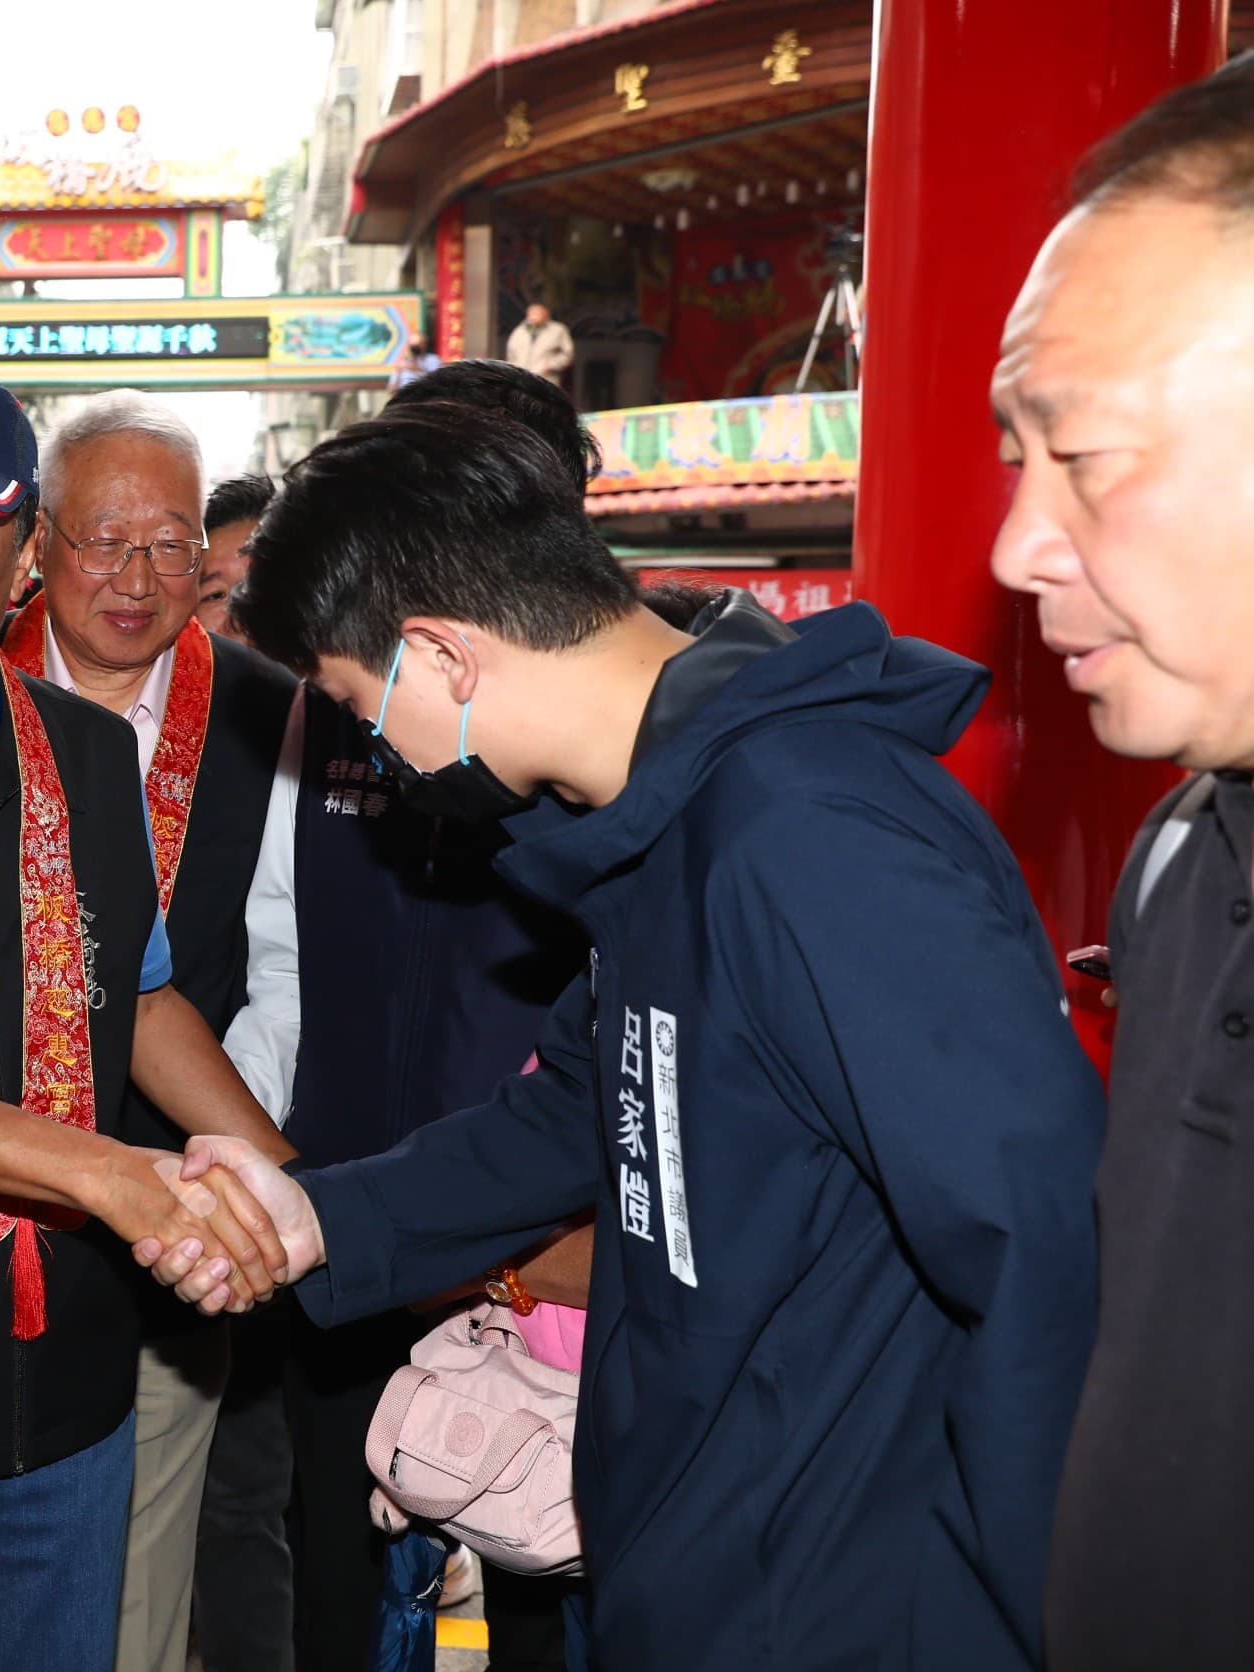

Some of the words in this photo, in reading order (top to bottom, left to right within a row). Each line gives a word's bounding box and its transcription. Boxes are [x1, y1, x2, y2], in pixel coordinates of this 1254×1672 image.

[748, 577, 852, 616] 媽祖
[617, 1004, 655, 1243] 呂家愷
[657, 1062, 689, 1267] 新北市議員
